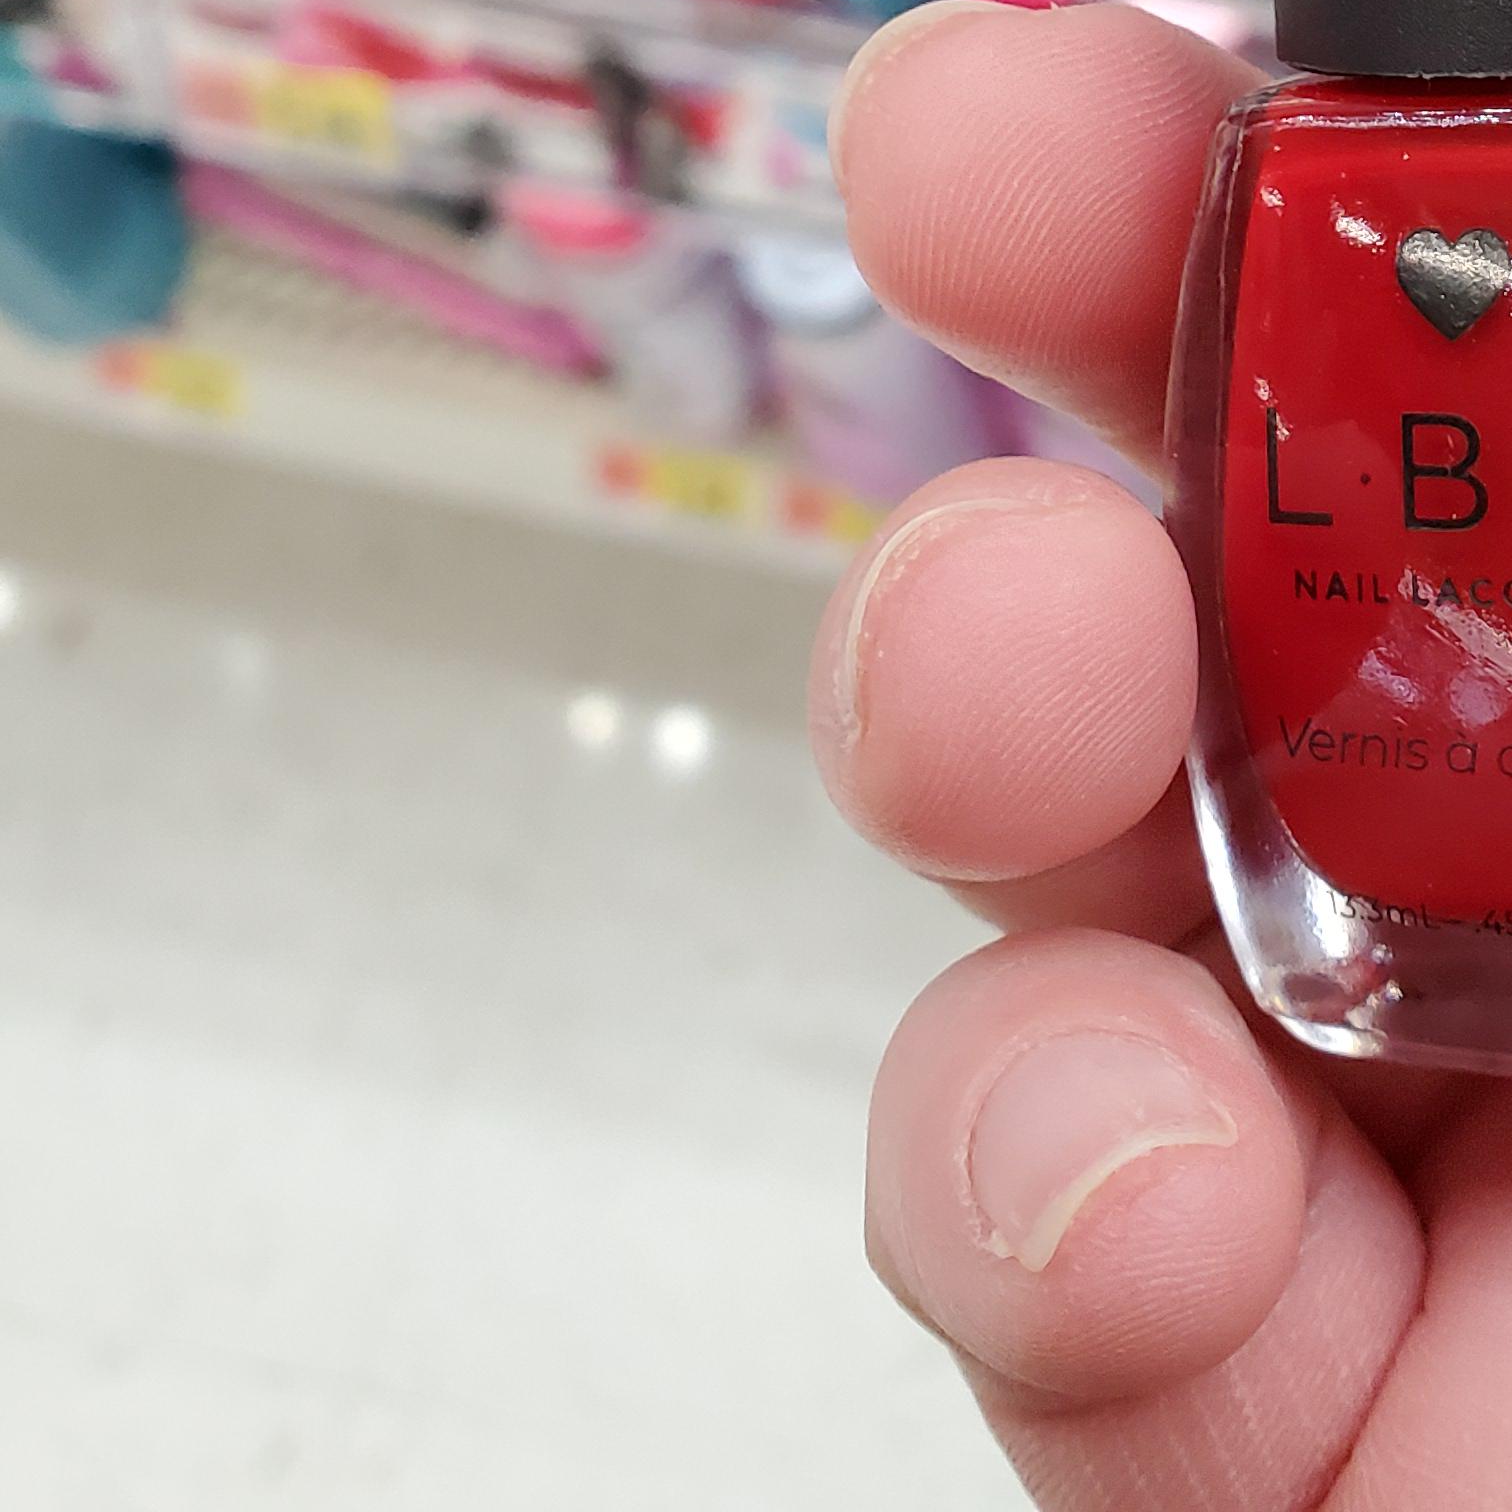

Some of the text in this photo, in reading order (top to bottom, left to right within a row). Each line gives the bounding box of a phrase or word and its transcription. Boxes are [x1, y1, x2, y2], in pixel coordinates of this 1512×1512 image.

[1294, 569, 1388, 604] NAIL
[1279, 716, 1430, 771] Vernis
[1446, 732, 1477, 773] à
